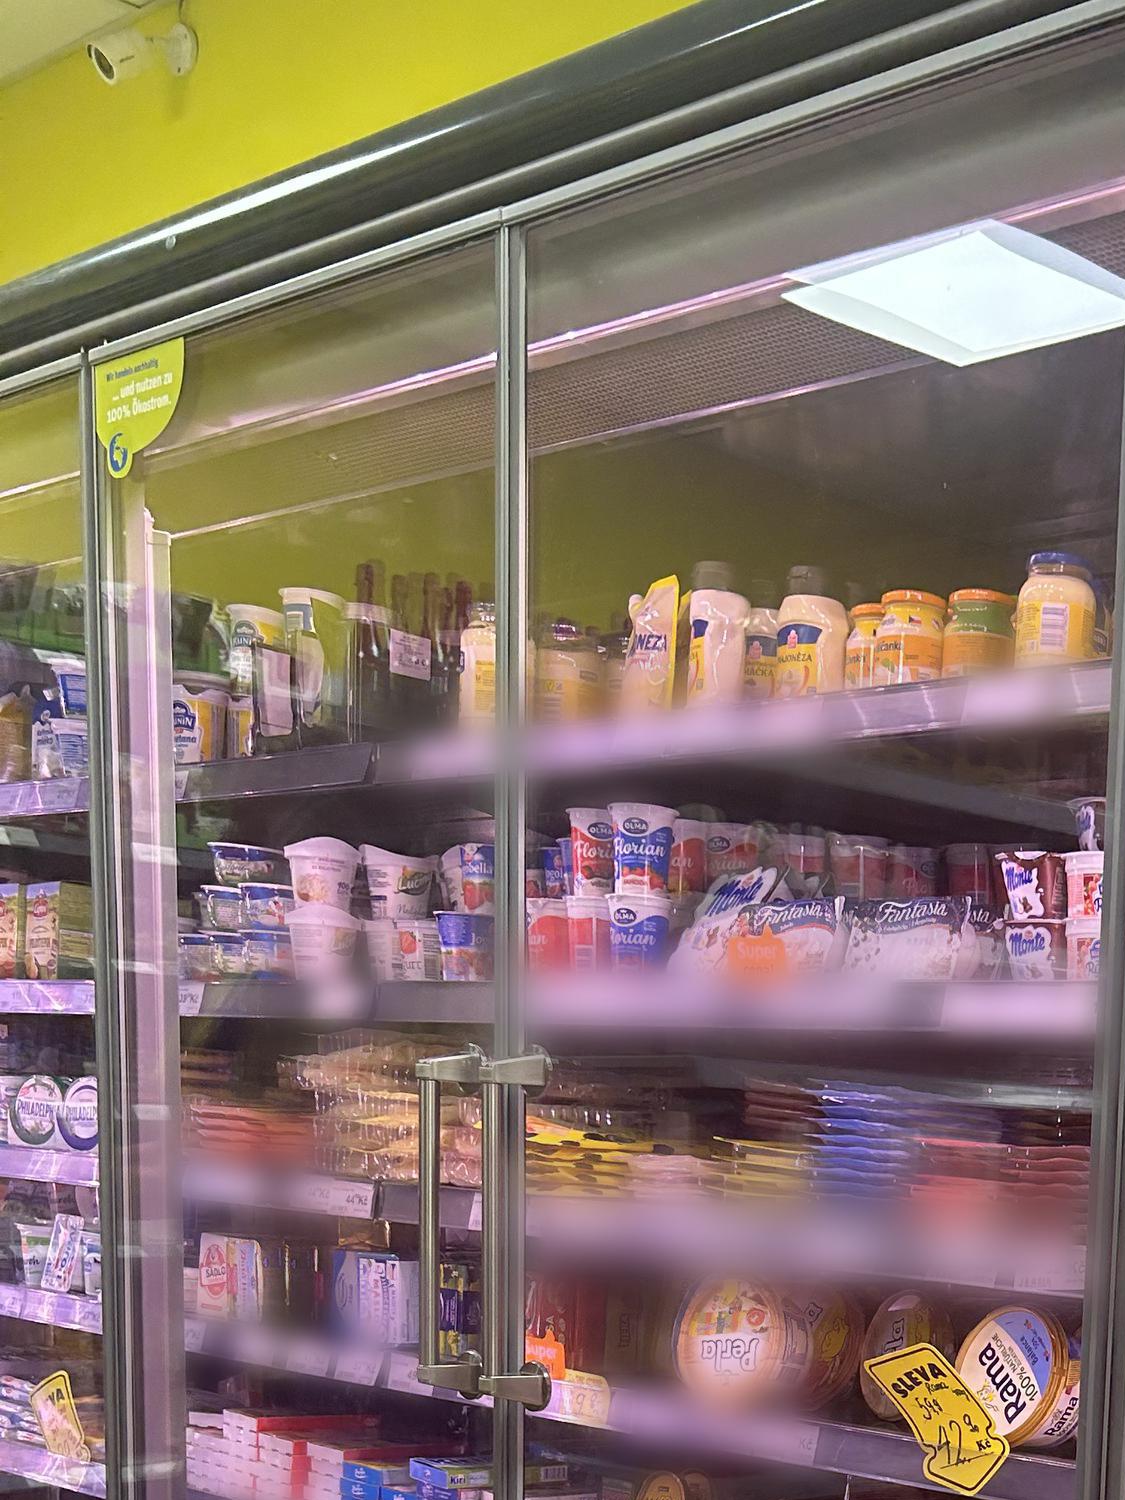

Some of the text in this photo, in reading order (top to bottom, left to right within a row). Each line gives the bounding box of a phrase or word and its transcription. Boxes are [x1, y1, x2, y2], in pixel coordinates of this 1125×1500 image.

[120, 373, 172, 399] und nutzen zu
[106, 394, 171, 423] 100% Ökostrom.
[624, 821, 647, 831] OLMA
[576, 841, 614, 859] Flori
[876, 901, 948, 924] Fantasia
[1009, 932, 1046, 957] Monte
[66, 1104, 98, 1121] PHILADELP
[528, 1343, 557, 1360] uper
[891, 1362, 947, 1399] SLEVA
[979, 1342, 1027, 1425] Rama
[1017, 1362, 1039, 1402] 100%
[1044, 1395, 1080, 1436] Rama
[976, 1439, 991, 1452] Kč
[450, 1474, 466, 1485] Kiri
